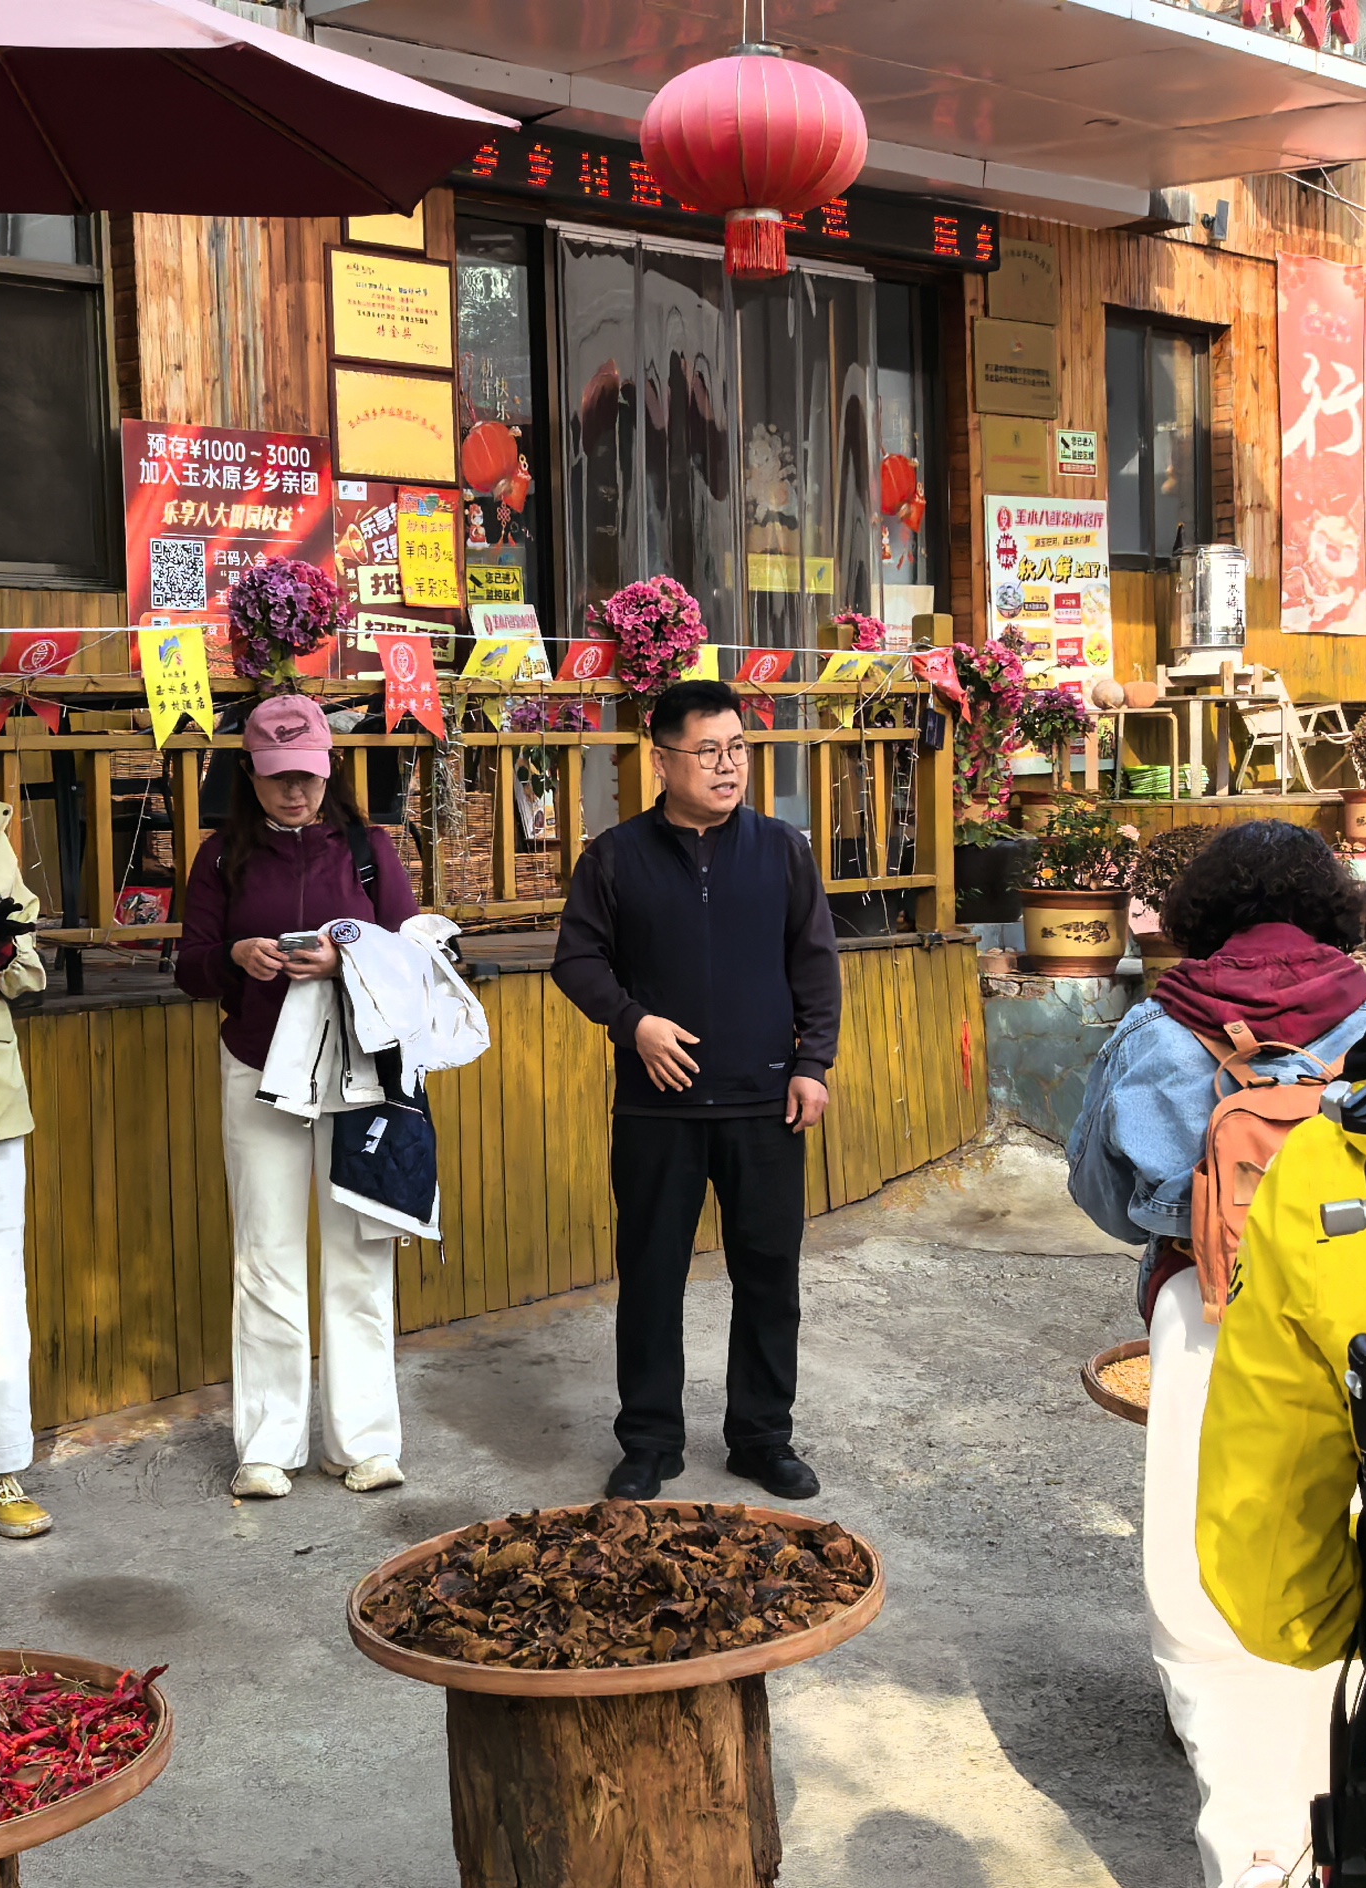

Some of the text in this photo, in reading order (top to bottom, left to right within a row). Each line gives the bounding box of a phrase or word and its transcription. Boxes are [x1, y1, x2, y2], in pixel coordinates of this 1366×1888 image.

[139, 458, 319, 496] 加入玉水原乡乡亲团
[161, 499, 294, 532] 乐享八大田园权益
[485, 571, 519, 585] 您已进入
